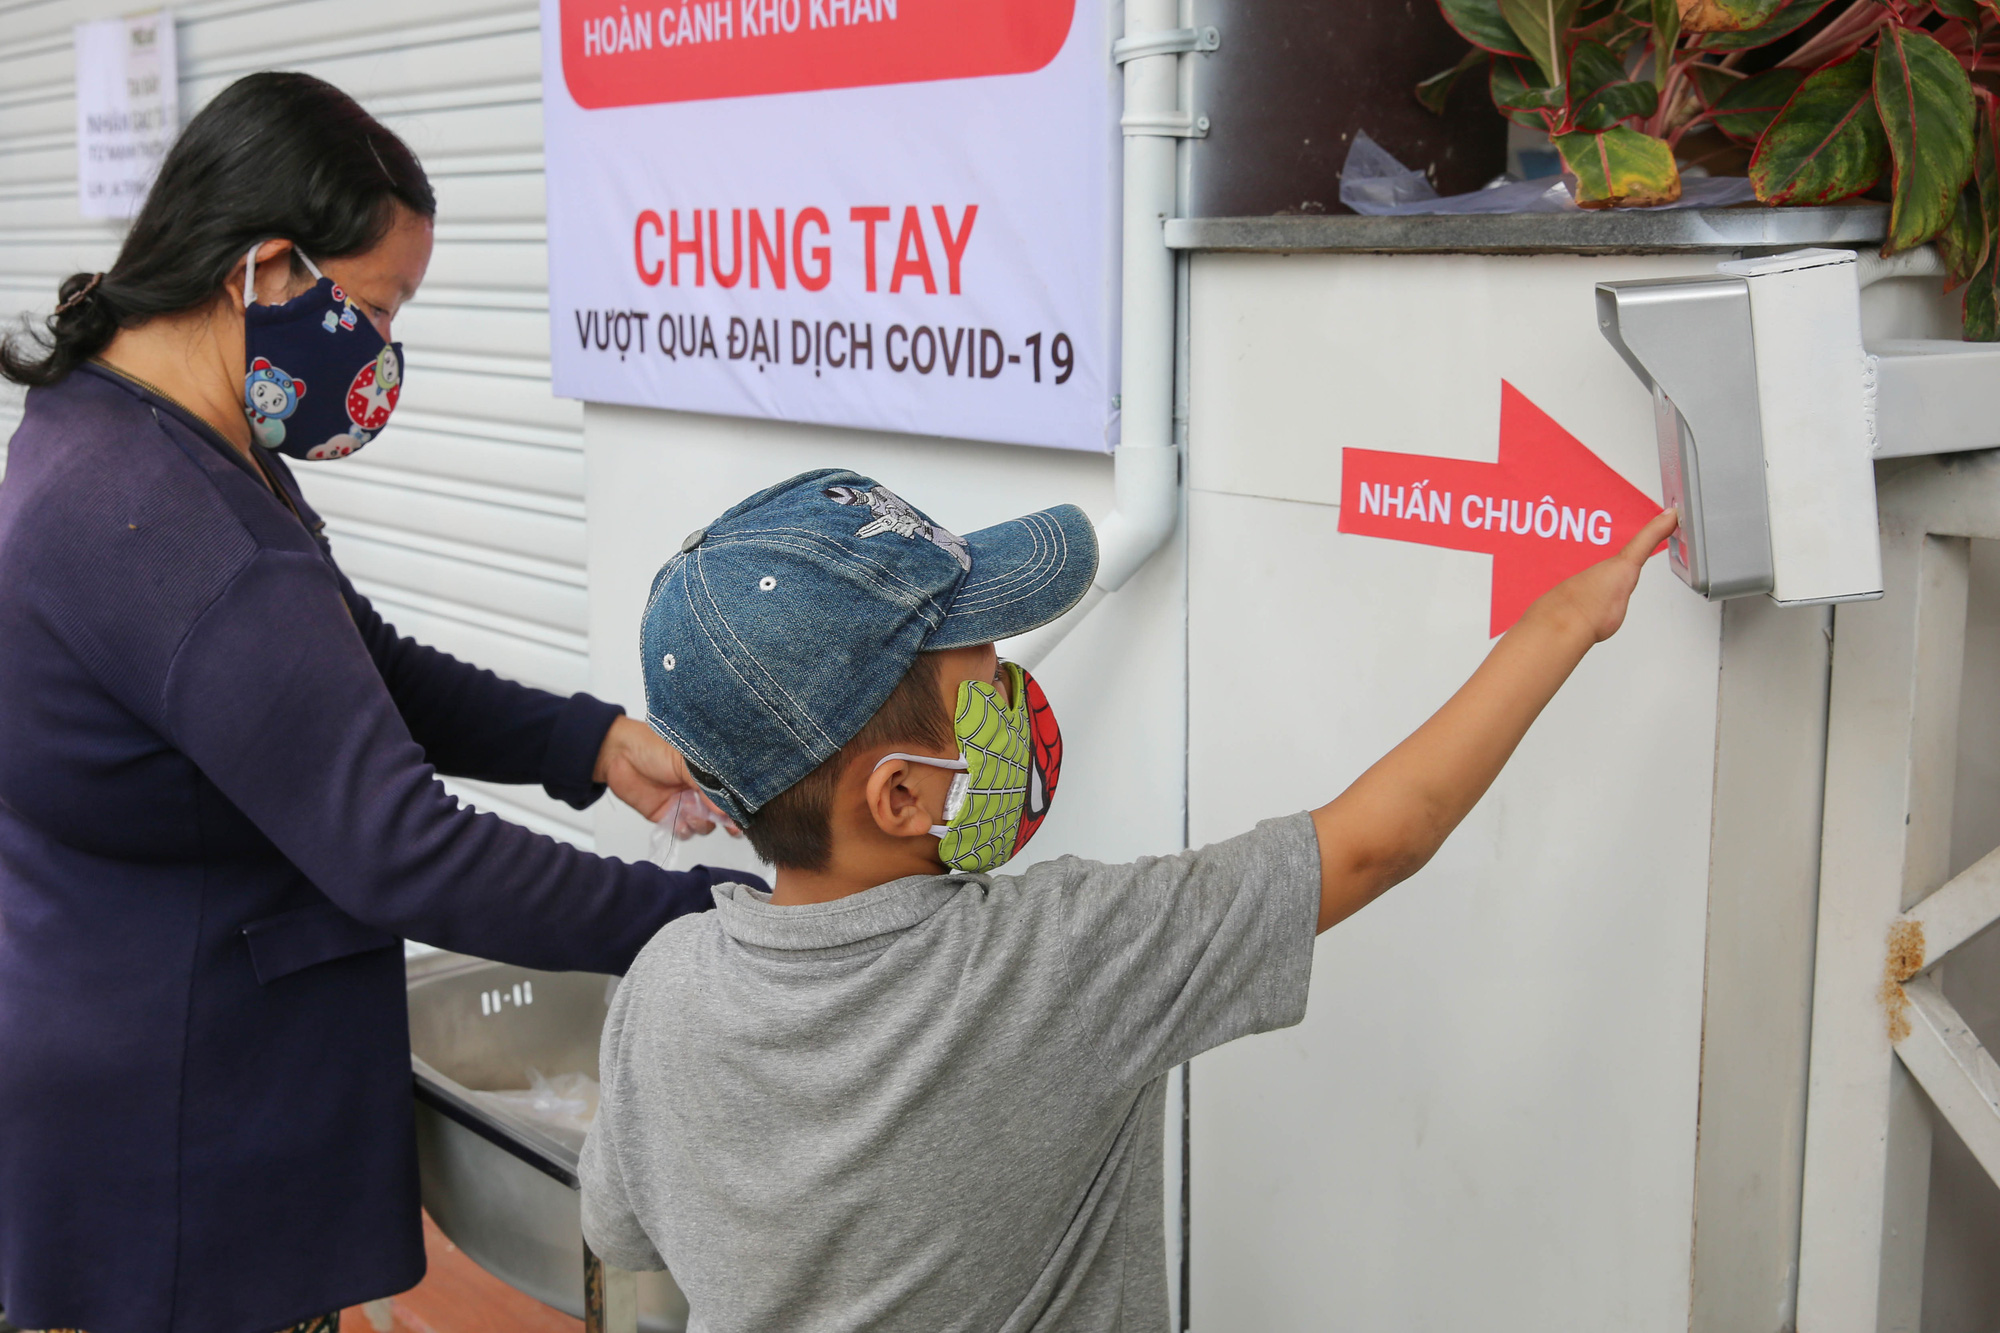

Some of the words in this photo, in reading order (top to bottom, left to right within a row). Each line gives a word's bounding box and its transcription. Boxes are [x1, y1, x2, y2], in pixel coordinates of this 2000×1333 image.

[584, 4, 653, 57] HOÀN
[634, 207, 832, 292] CHUNG
[850, 204, 979, 295] TAY
[575, 309, 649, 362] VƯỢT
[658, 313, 718, 361] QUA
[726, 316, 780, 373] ĐẠI
[792, 320, 873, 378] DỊCH
[885, 324, 1075, 385] COVID-19
[1358, 479, 1451, 525] NHẤN
[1461, 495, 1613, 546] CHUÔNG
